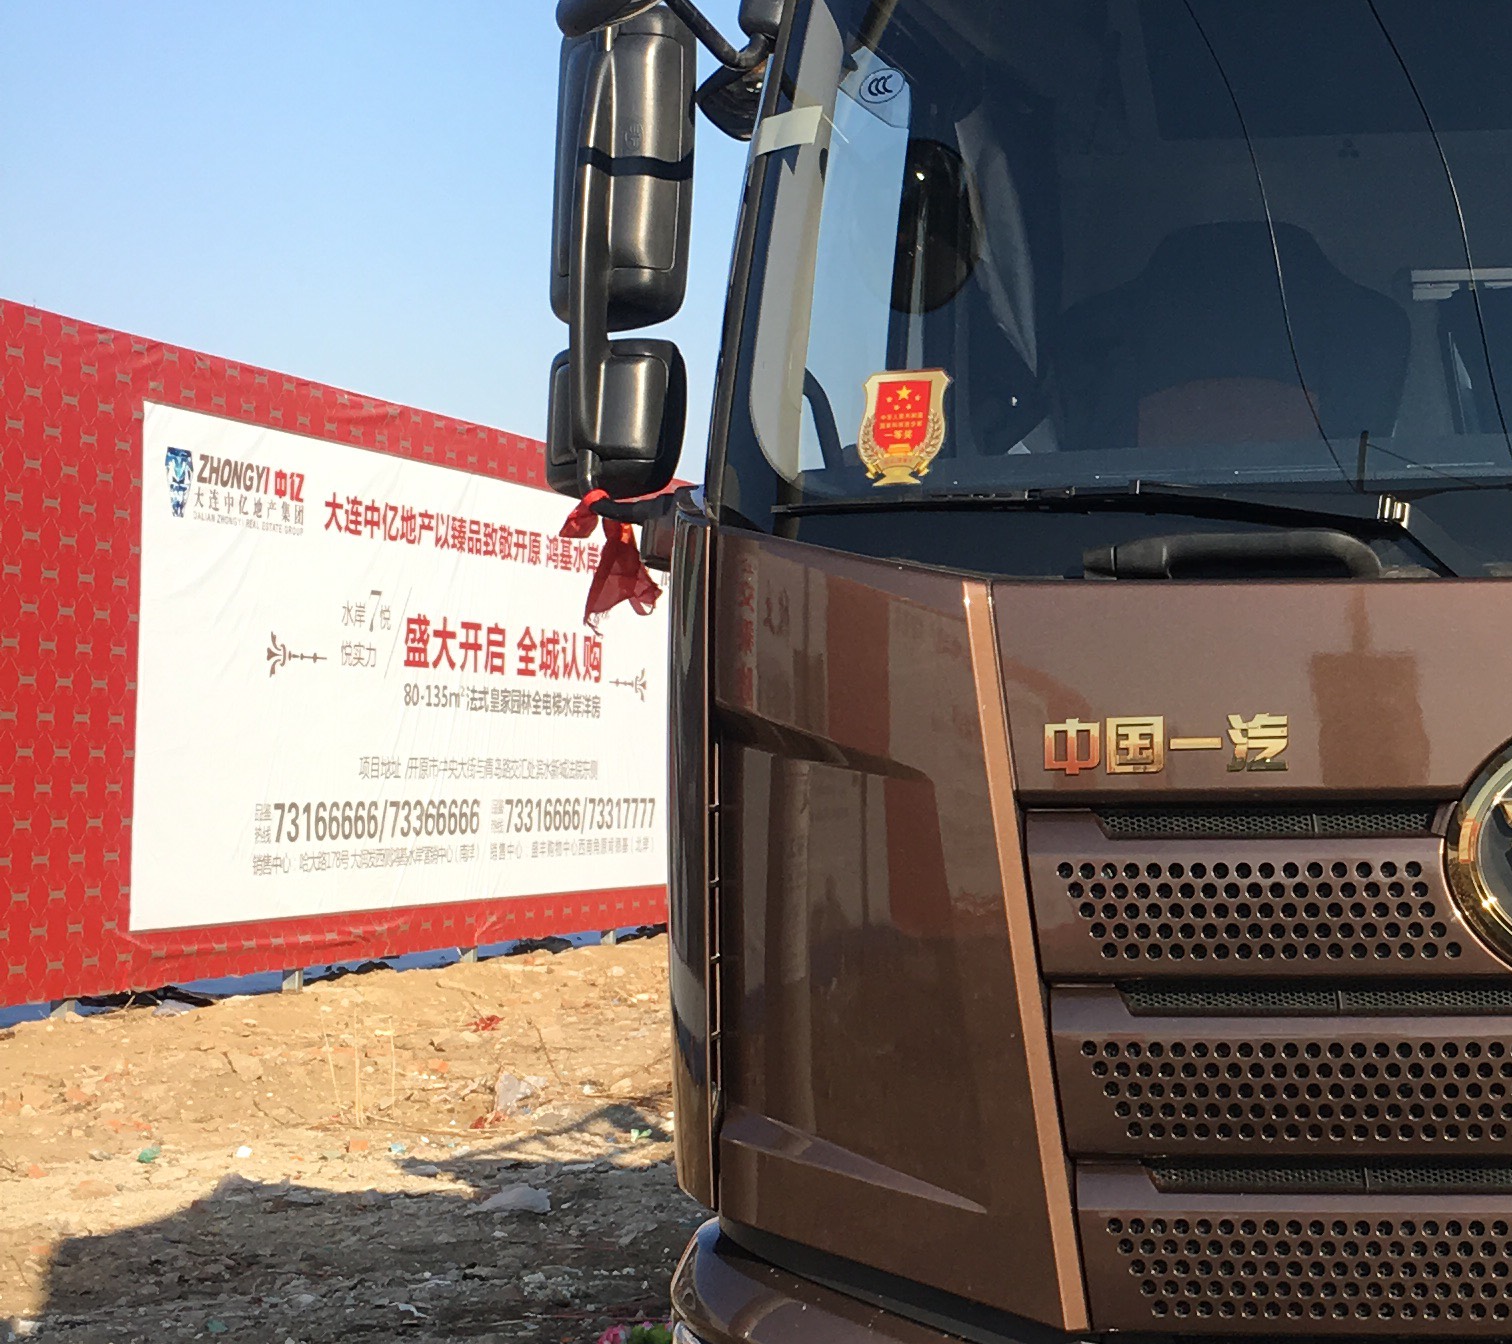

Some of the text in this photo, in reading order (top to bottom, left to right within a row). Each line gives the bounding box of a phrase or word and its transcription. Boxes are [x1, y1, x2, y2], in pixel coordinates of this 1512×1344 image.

[196, 453, 305, 503] ZHONGYI 中亿
[194, 486, 305, 526] 大连中亿地产集团
[324, 492, 542, 567] 大连中亿地产以臻品致敬开原
[404, 613, 603, 684] 盛大开启 全城认购
[1043, 711, 1290, 776] 中国一汽
[273, 799, 481, 843] 73166666/73366666
[505, 797, 656, 835] 73316666/73317777
